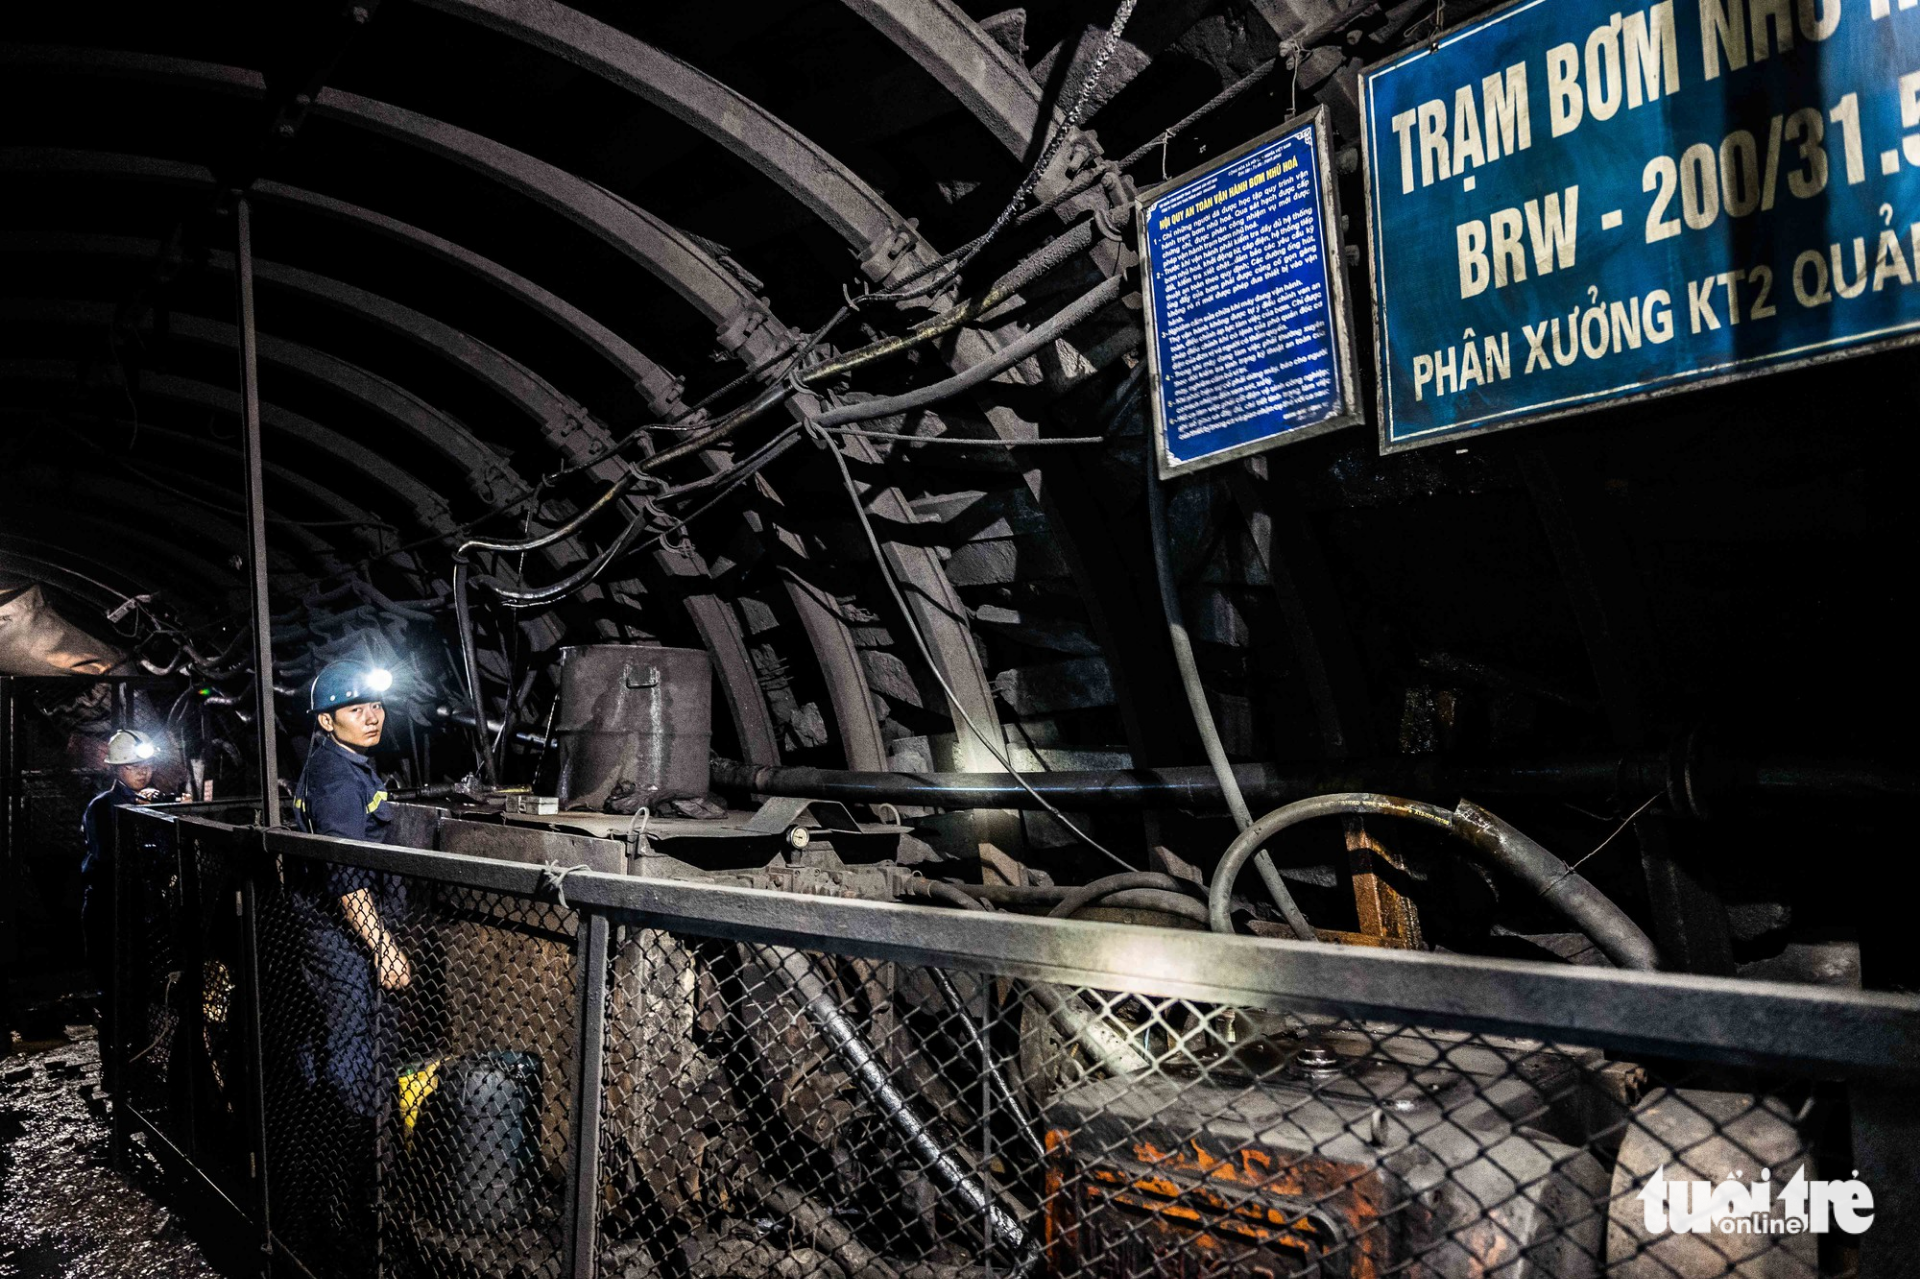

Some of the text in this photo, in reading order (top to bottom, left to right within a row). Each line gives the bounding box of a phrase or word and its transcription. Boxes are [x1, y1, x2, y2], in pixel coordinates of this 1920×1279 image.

[1391, 60, 1532, 195] TRẠM
[1546, 0, 1680, 138] BƠM
[1159, 216, 1171, 230] NỘI
[1171, 210, 1184, 225] QUY
[1185, 206, 1194, 218] AN
[1195, 197, 1213, 213] TOÀN
[1214, 190, 1228, 204] VẬN
[1228, 180, 1248, 198] HÀNH
[1249, 172, 1265, 188] BƠM
[1266, 163, 1282, 180] NHŨ
[1282, 155, 1298, 173] HOÁ
[1264, 184, 1277, 195] quy
[1456, 184, 1579, 299] BRW
[1601, 209, 1623, 230] -
[1413, 326, 1511, 402] PHÂN
[1521, 285, 1675, 375] XƯỞNG
[1688, 264, 1777, 334] KT2
[1792, 202, 1920, 308] QUẢ
